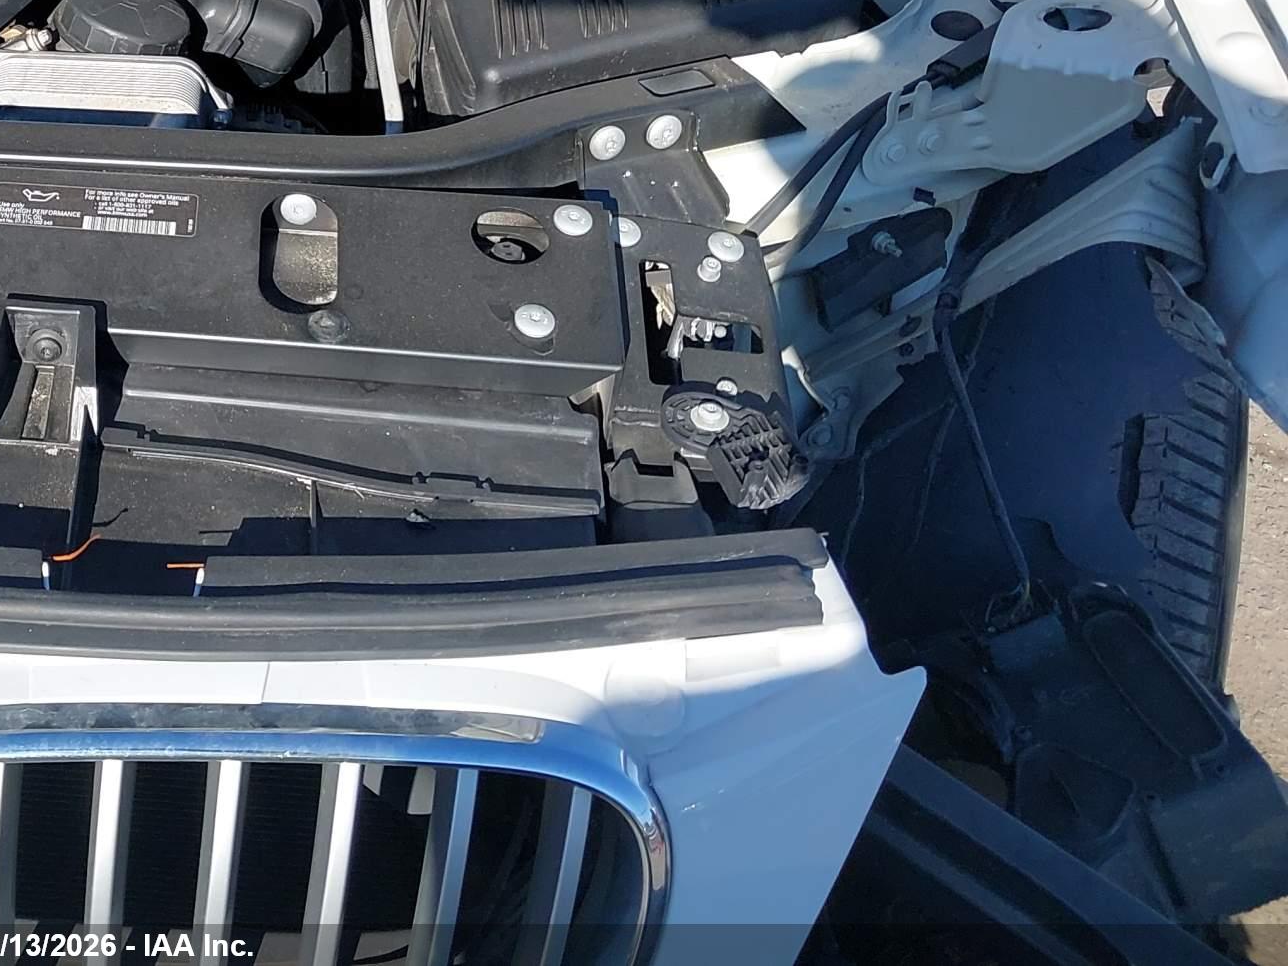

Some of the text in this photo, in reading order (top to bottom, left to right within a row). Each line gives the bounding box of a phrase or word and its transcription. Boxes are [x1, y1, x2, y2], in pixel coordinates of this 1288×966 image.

[139, 192, 166, 200] Owner's
[166, 194, 190, 202] Manual
[32, 208, 81, 218] PERFORMANCE
